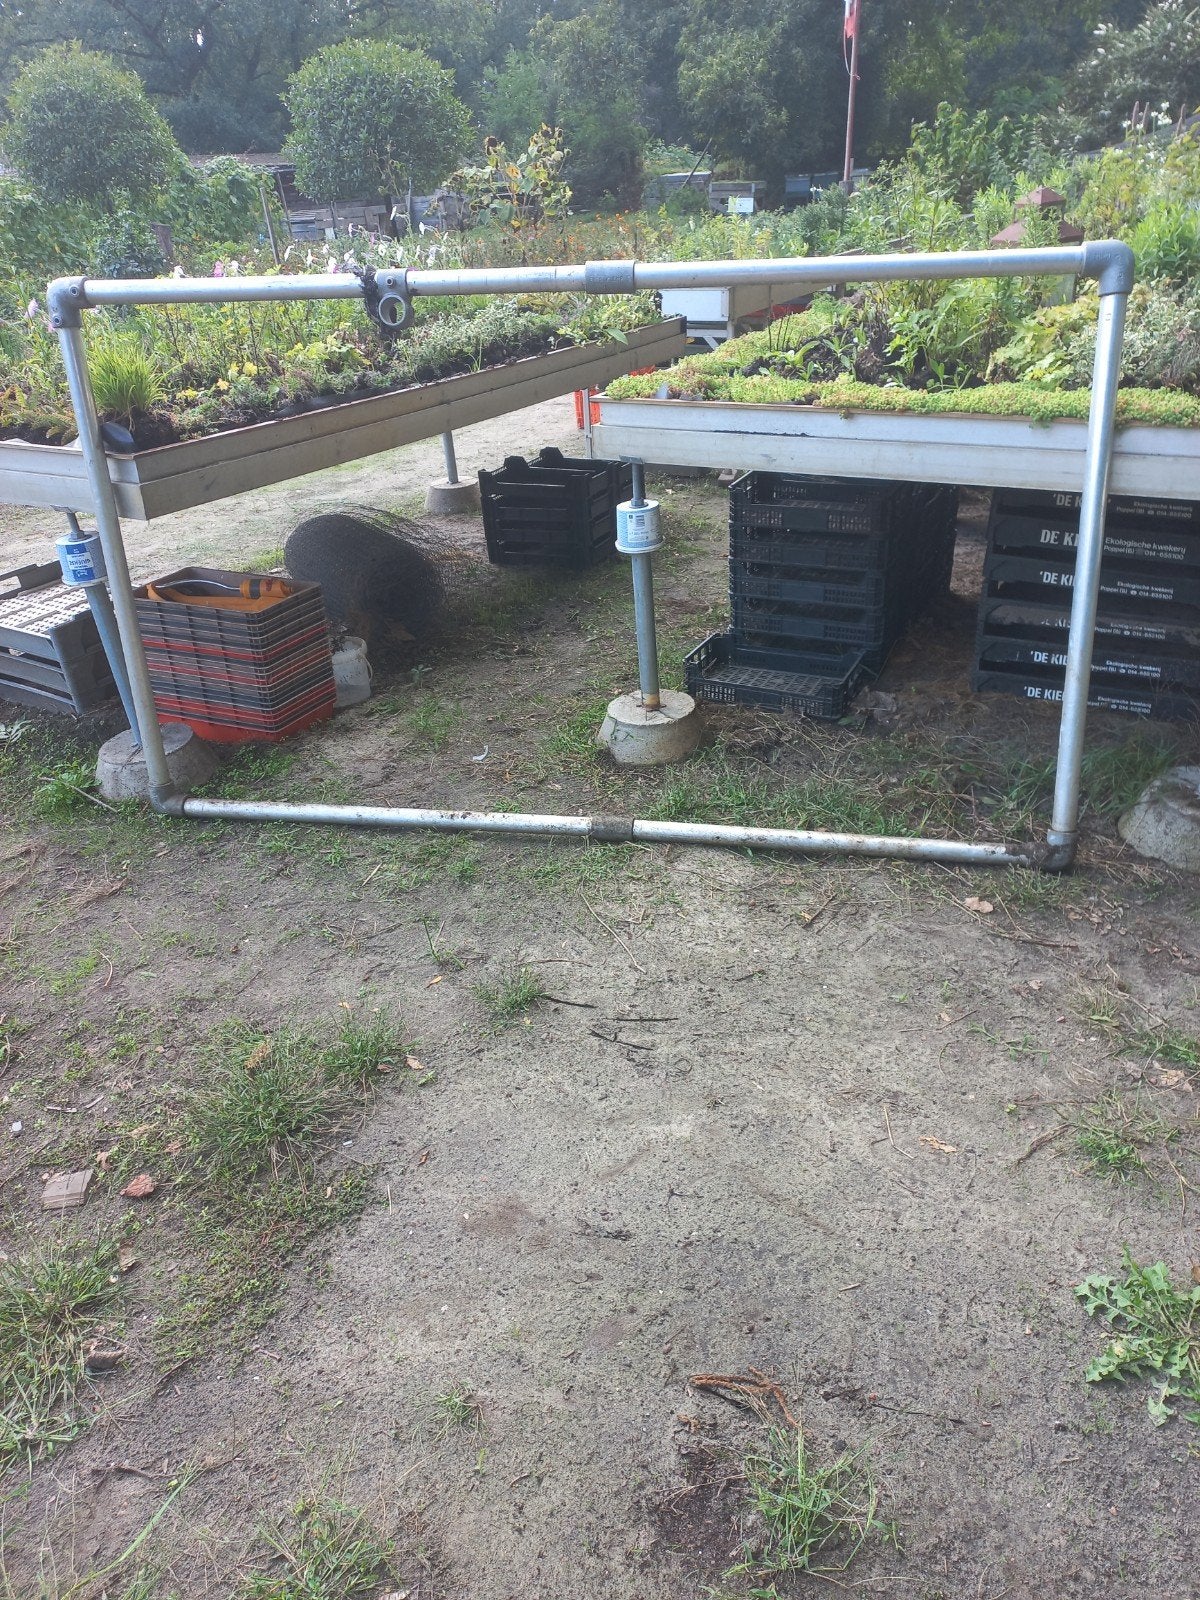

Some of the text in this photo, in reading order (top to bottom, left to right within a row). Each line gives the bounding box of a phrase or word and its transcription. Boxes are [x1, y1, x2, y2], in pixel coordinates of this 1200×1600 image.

[1040, 529, 1060, 544] DE
[1105, 537, 1151, 549] Ekologische
[1104, 545, 1125, 554] Poppel
[1117, 581, 1150, 590] Ekologische
[1044, 689, 1065, 702] KIE
